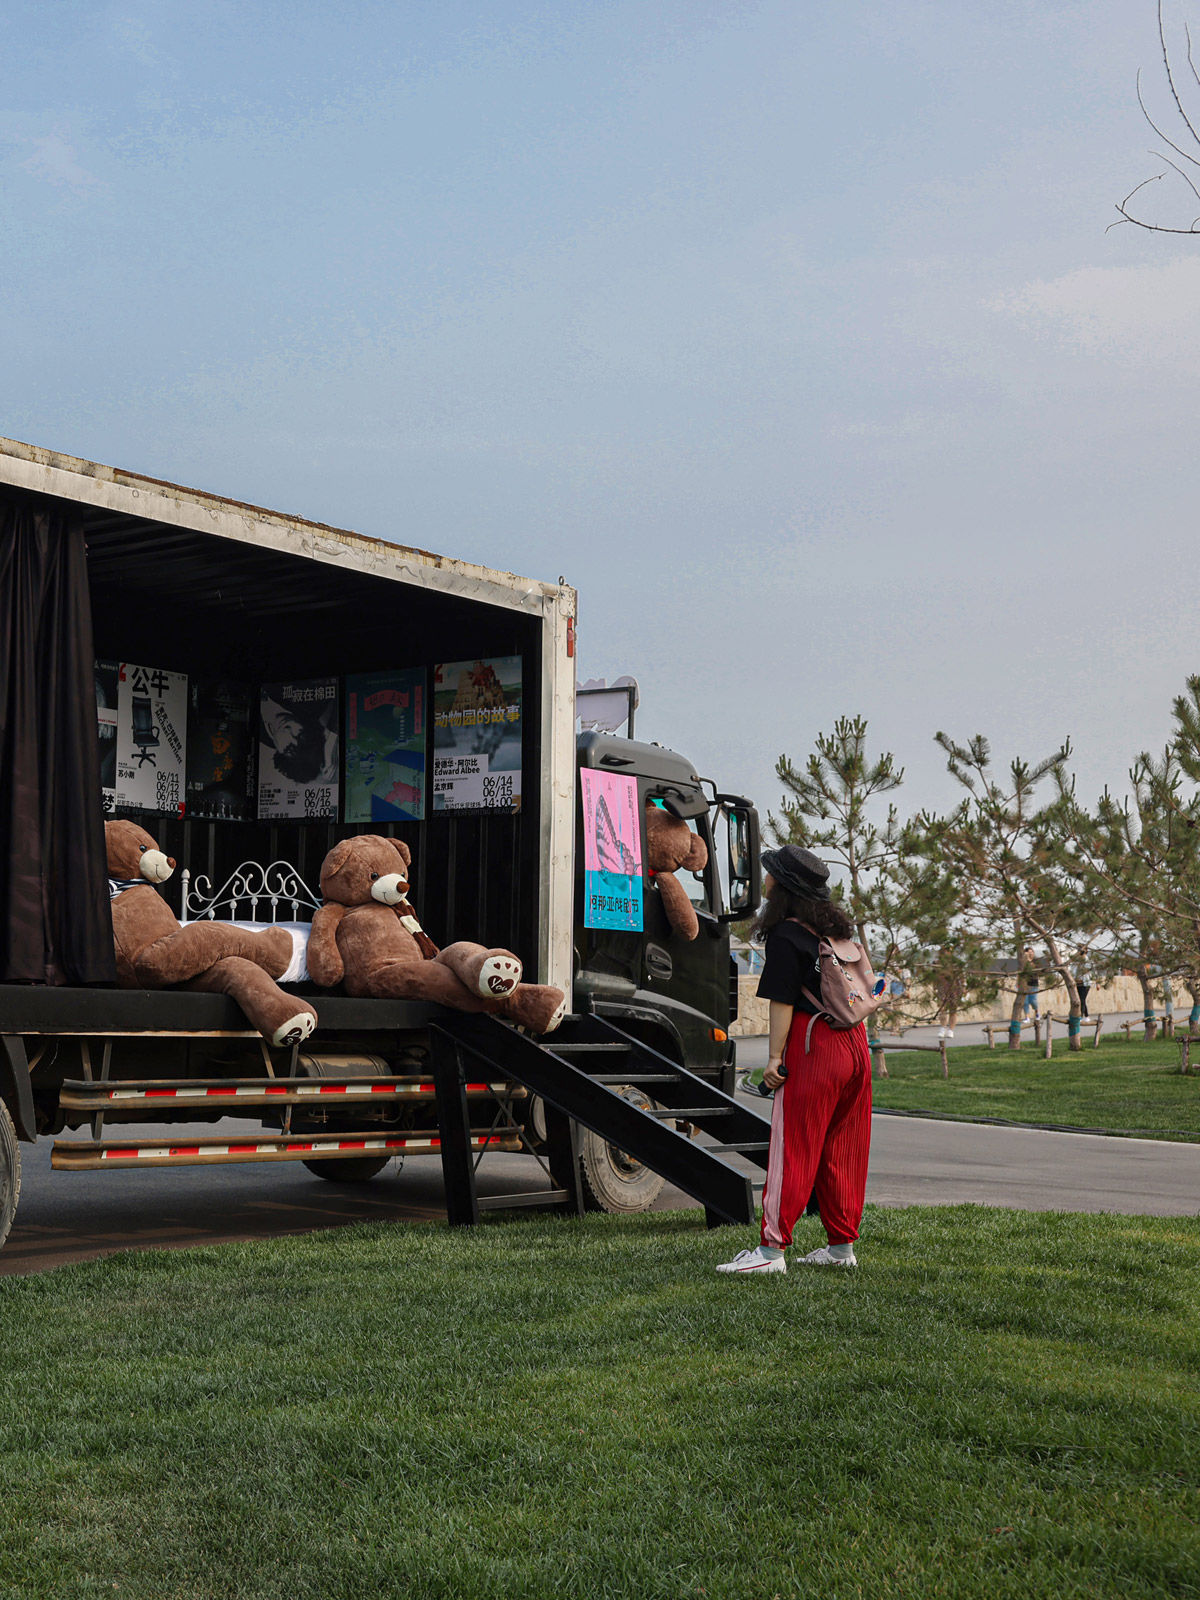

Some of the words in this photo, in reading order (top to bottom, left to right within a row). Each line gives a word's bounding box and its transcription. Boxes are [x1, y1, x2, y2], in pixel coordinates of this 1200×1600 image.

[131, 667, 170, 698] 公牛
[434, 704, 521, 728] 动物园的故事
[434, 766, 460, 776] Edward
[460, 765, 481, 775] Albee
[157, 771, 179, 783] 06/11
[483, 775, 513, 788] 06/14
[156, 781, 179, 793] 06/12
[483, 786, 513, 798] 06/15
[156, 791, 179, 802] 06/13
[305, 788, 331, 800] 06/15
[157, 800, 178, 813] 14:00
[305, 797, 331, 809] 06/16
[483, 797, 513, 808] 14:00
[305, 808, 331, 818] 16:00
